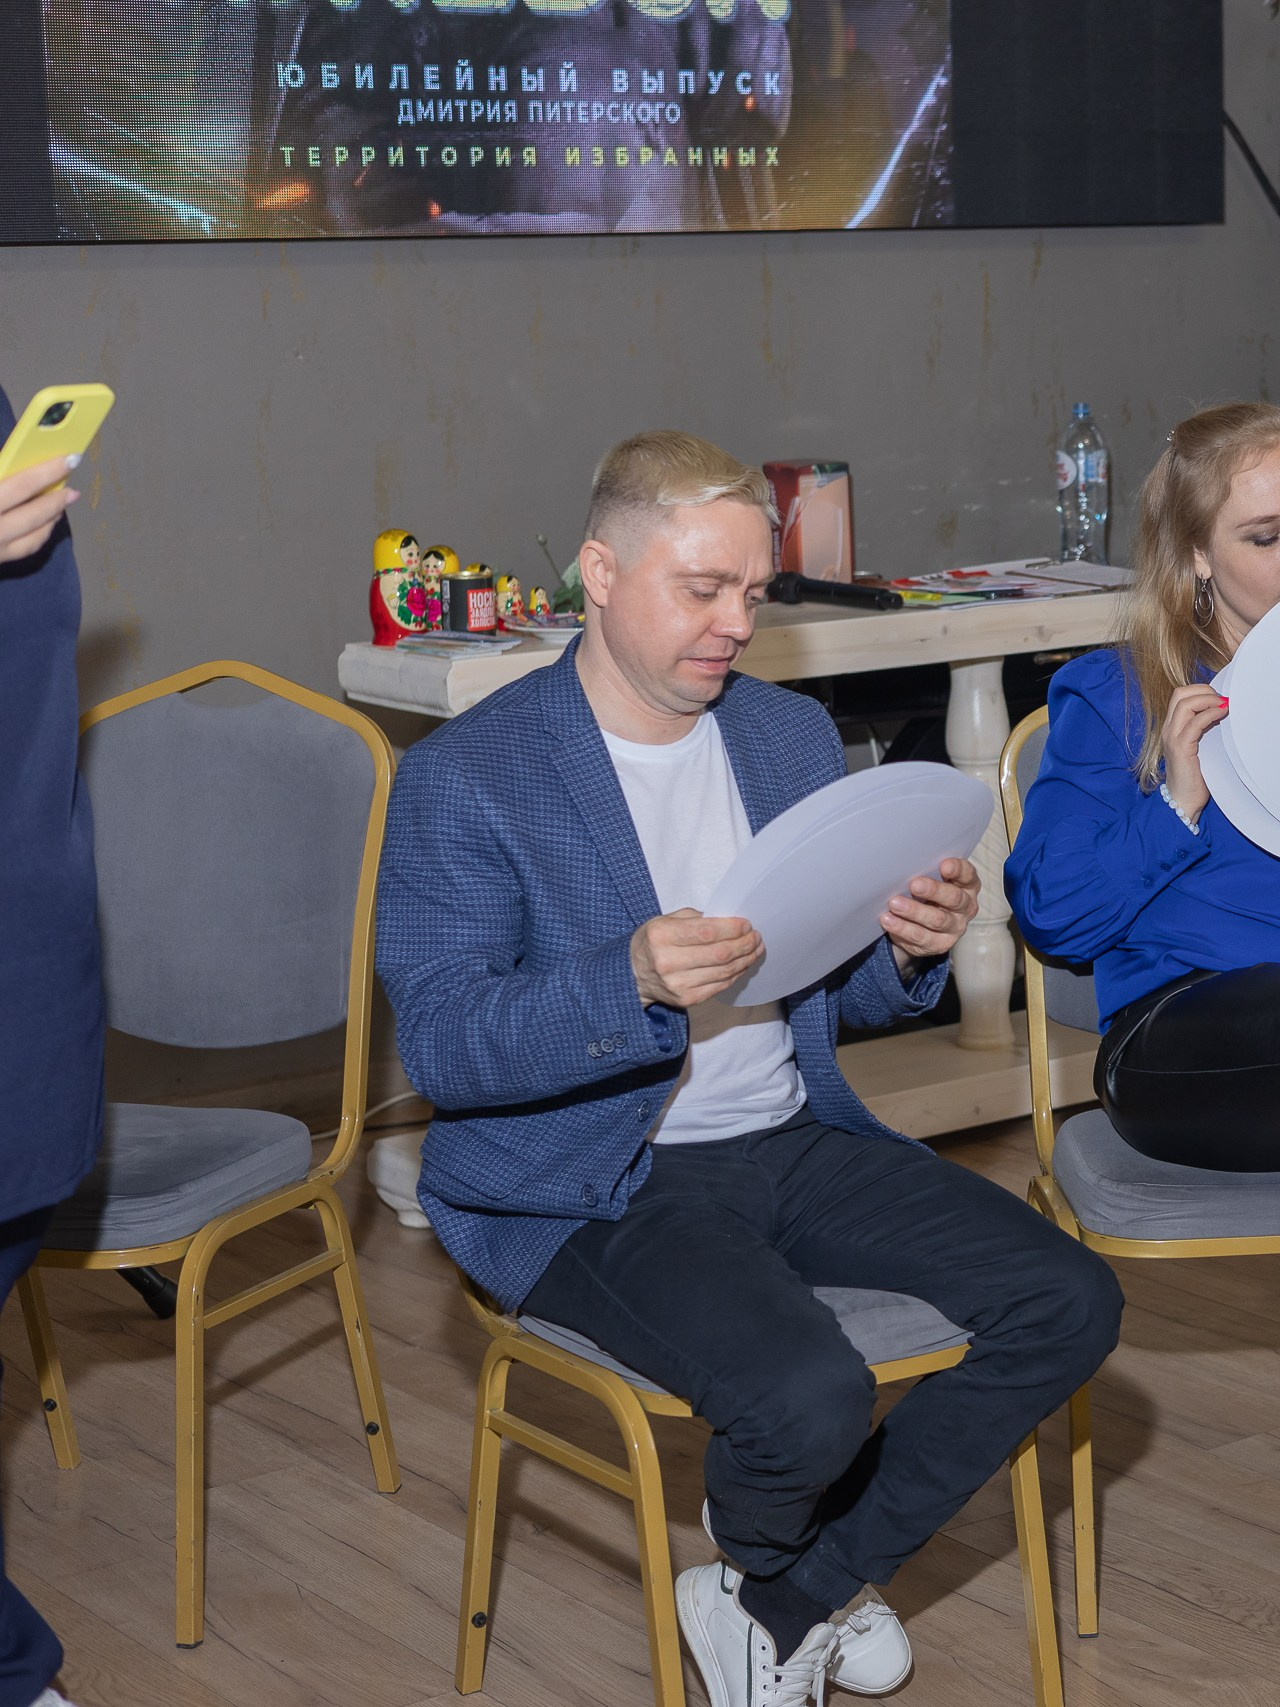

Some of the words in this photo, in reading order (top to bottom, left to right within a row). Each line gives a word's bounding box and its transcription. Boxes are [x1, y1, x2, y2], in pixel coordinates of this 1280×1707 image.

[276, 59, 578, 92] ЮБИЛЕЙНЫЙ
[611, 69, 781, 95] ВЫПУСК
[397, 98, 517, 126] ДМИТРИЯ
[527, 100, 682, 124] ПИТЕРСКОГО
[279, 146, 537, 167] ТЕРРИТОРИЯ
[564, 146, 780, 167] ИЗБРАННЫХ
